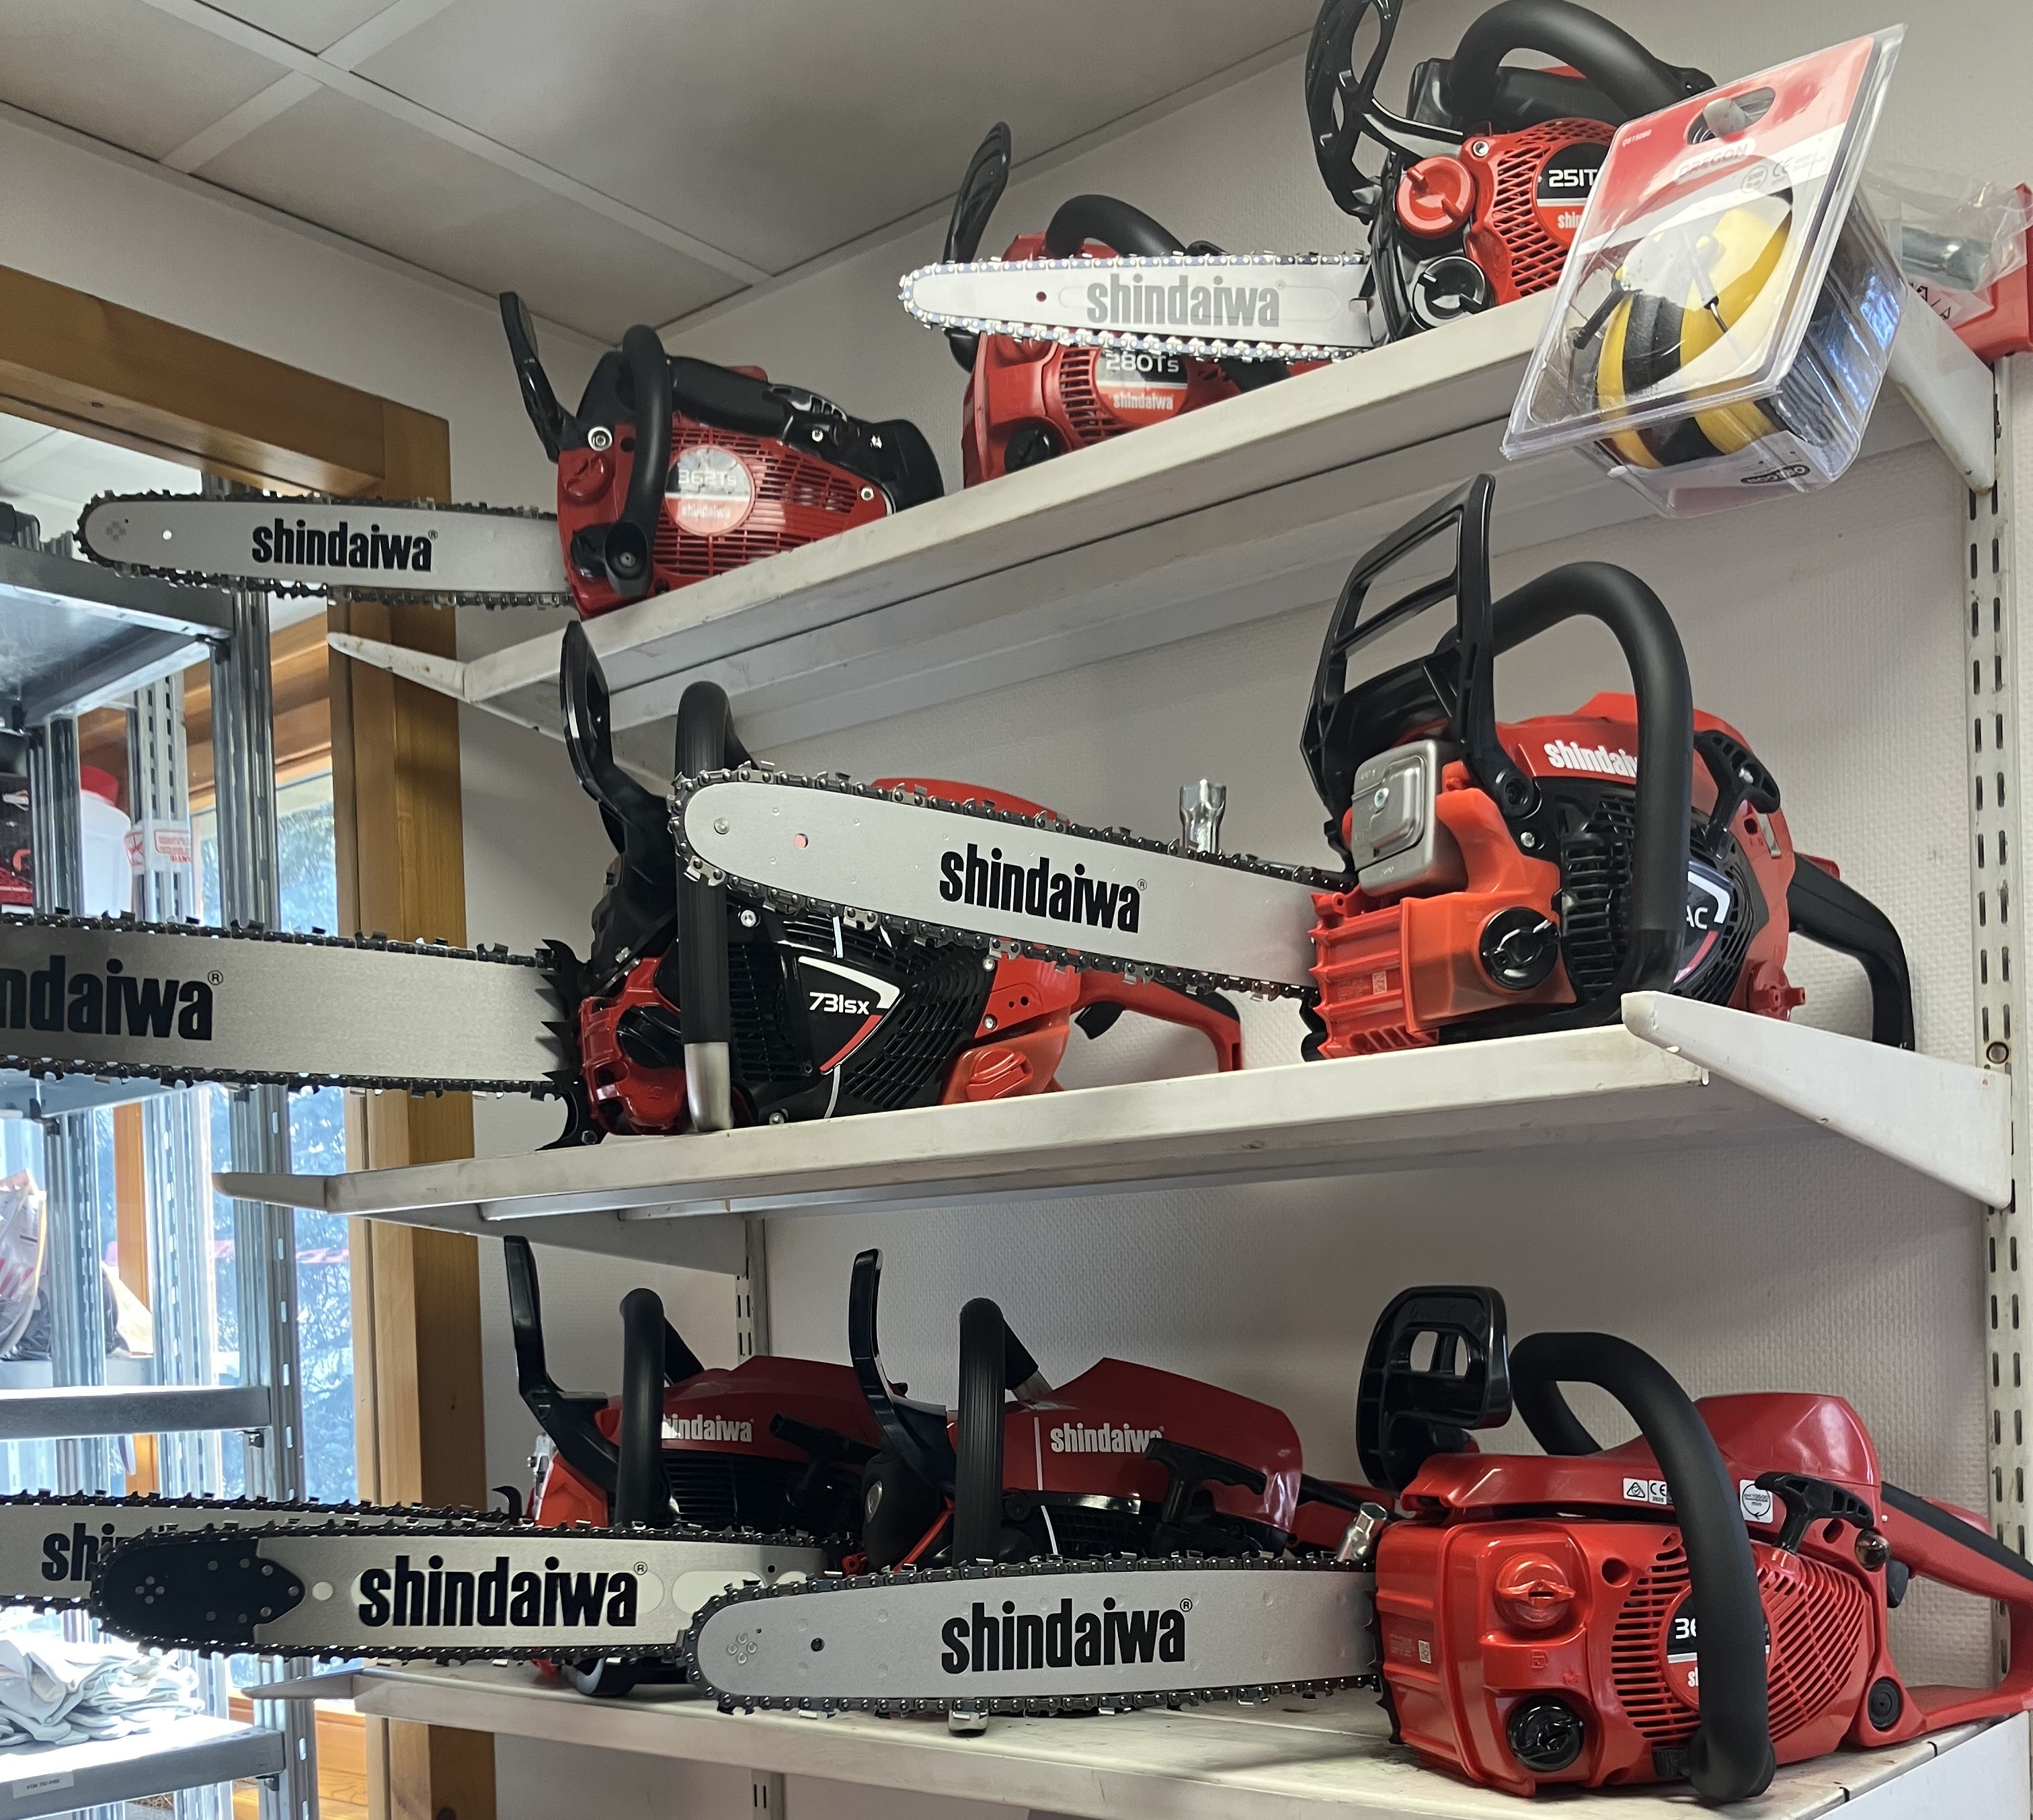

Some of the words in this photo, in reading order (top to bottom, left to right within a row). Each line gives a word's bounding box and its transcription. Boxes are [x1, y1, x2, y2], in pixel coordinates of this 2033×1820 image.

[1548, 169, 1598, 188] 251T
[1113, 391, 1174, 410] shindaiwa
[1544, 739, 1638, 779] shindai
[0, 955, 213, 1041] ndaiwa
[662, 1413, 752, 1443] hindaiwa
